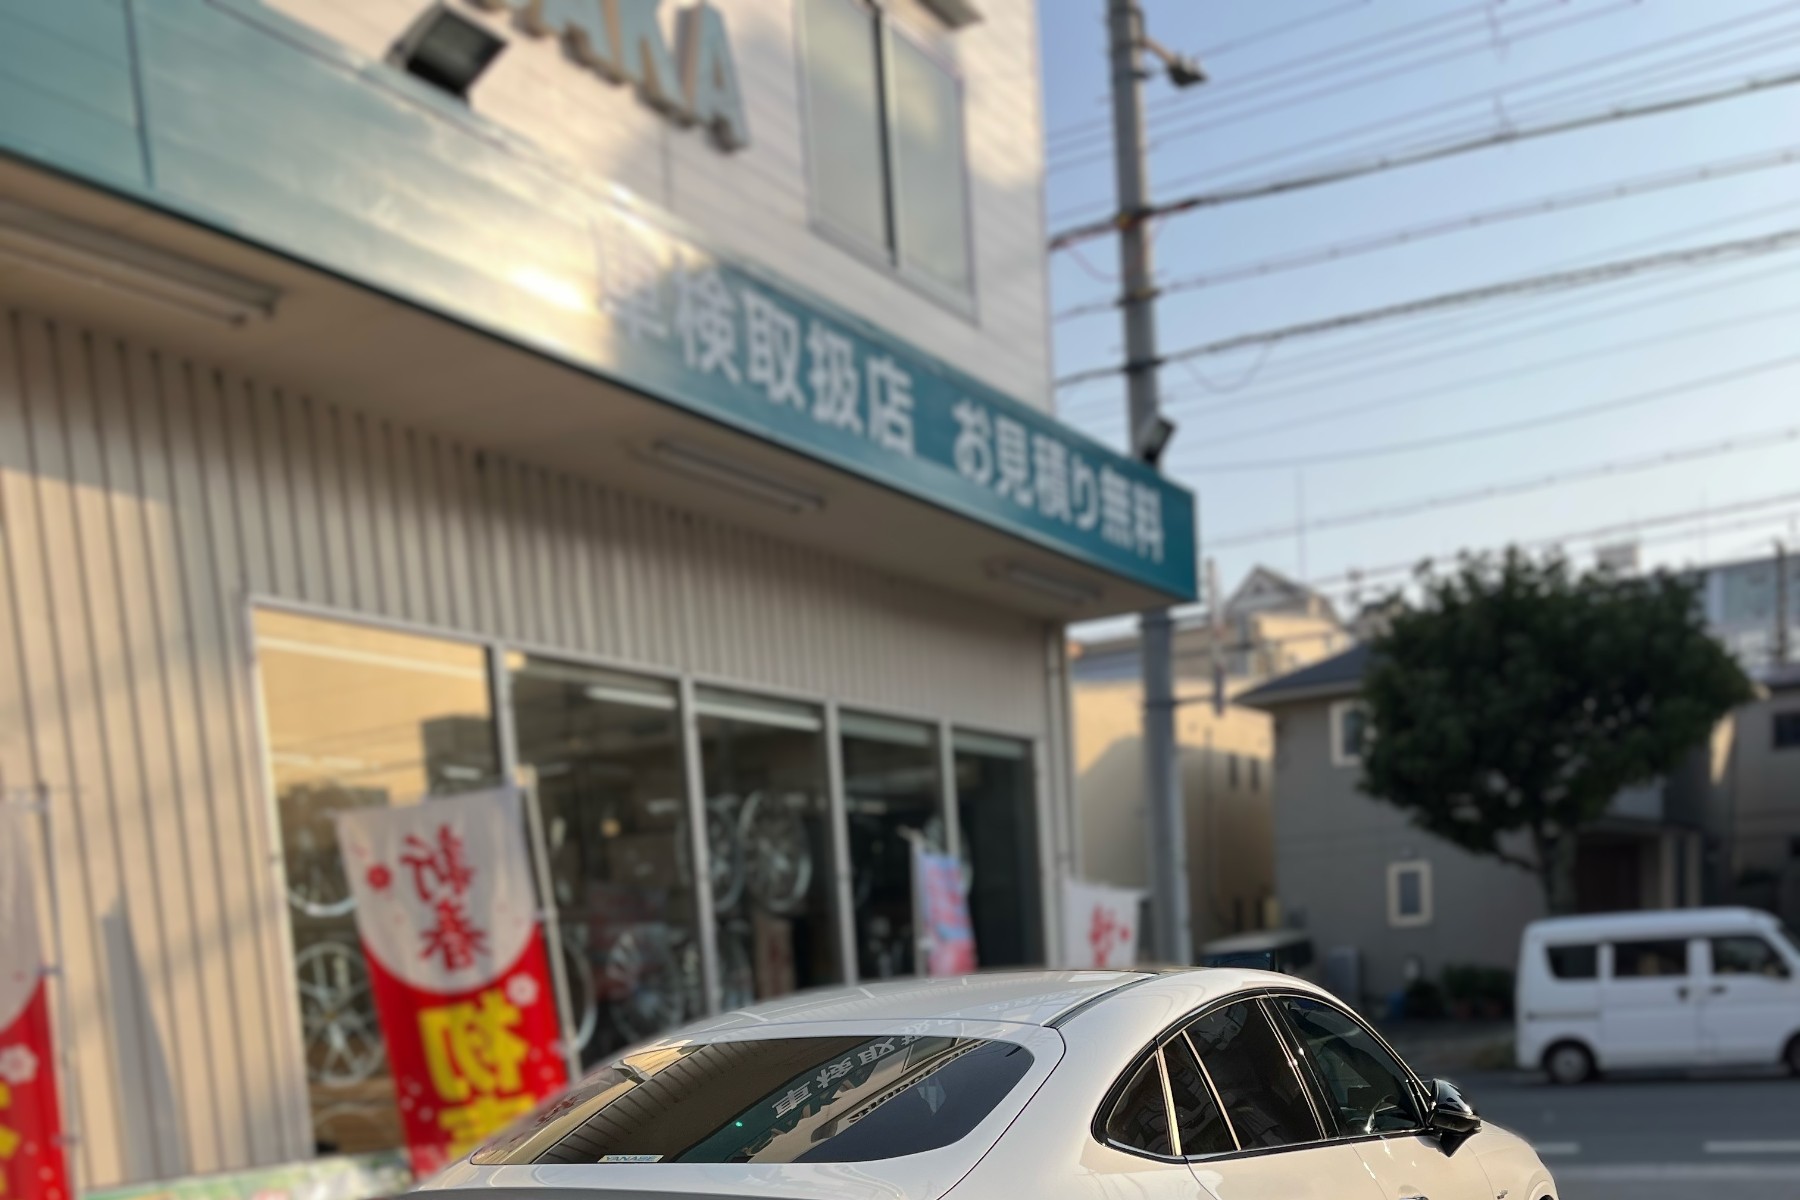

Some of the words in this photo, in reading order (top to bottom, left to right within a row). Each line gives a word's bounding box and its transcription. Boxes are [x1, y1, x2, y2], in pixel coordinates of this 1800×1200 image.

[953, 399, 1165, 564] お見積り無料
